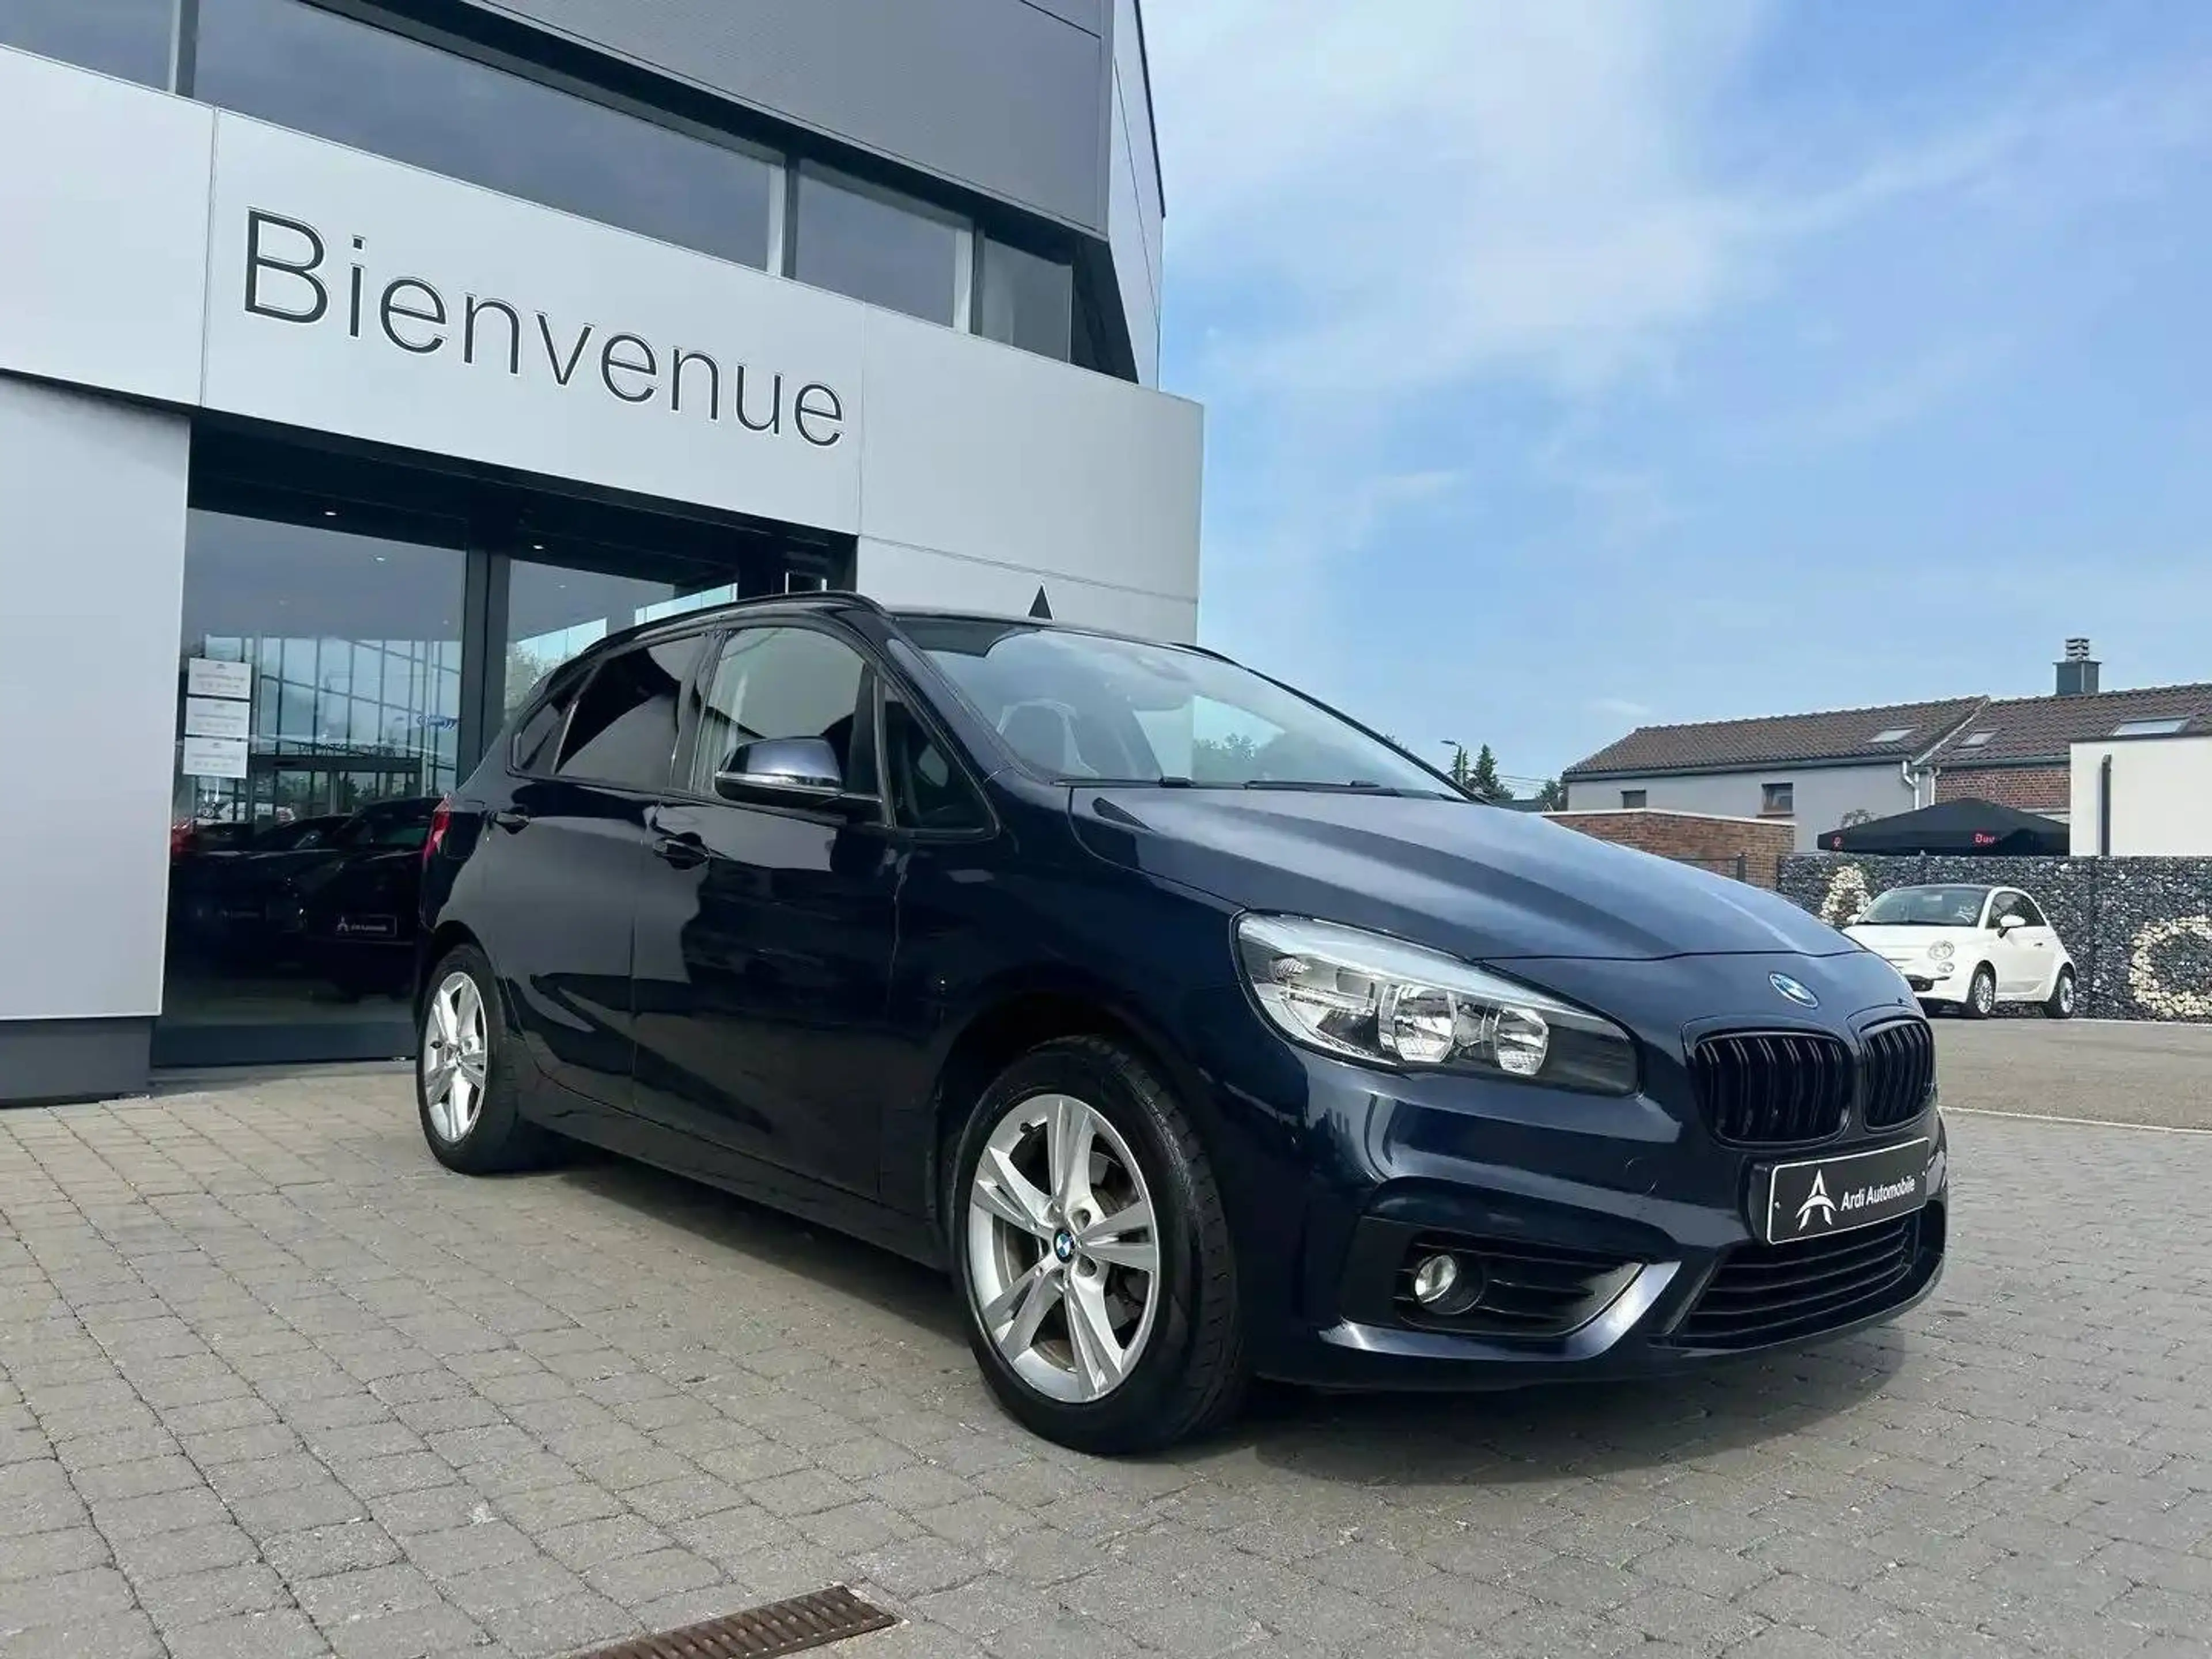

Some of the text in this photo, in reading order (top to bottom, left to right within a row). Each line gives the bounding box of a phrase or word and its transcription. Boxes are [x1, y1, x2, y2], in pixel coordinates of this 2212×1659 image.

[244, 208, 843, 447] Bienvenue
[1840, 1175, 1916, 1211] Ardi Automobile
